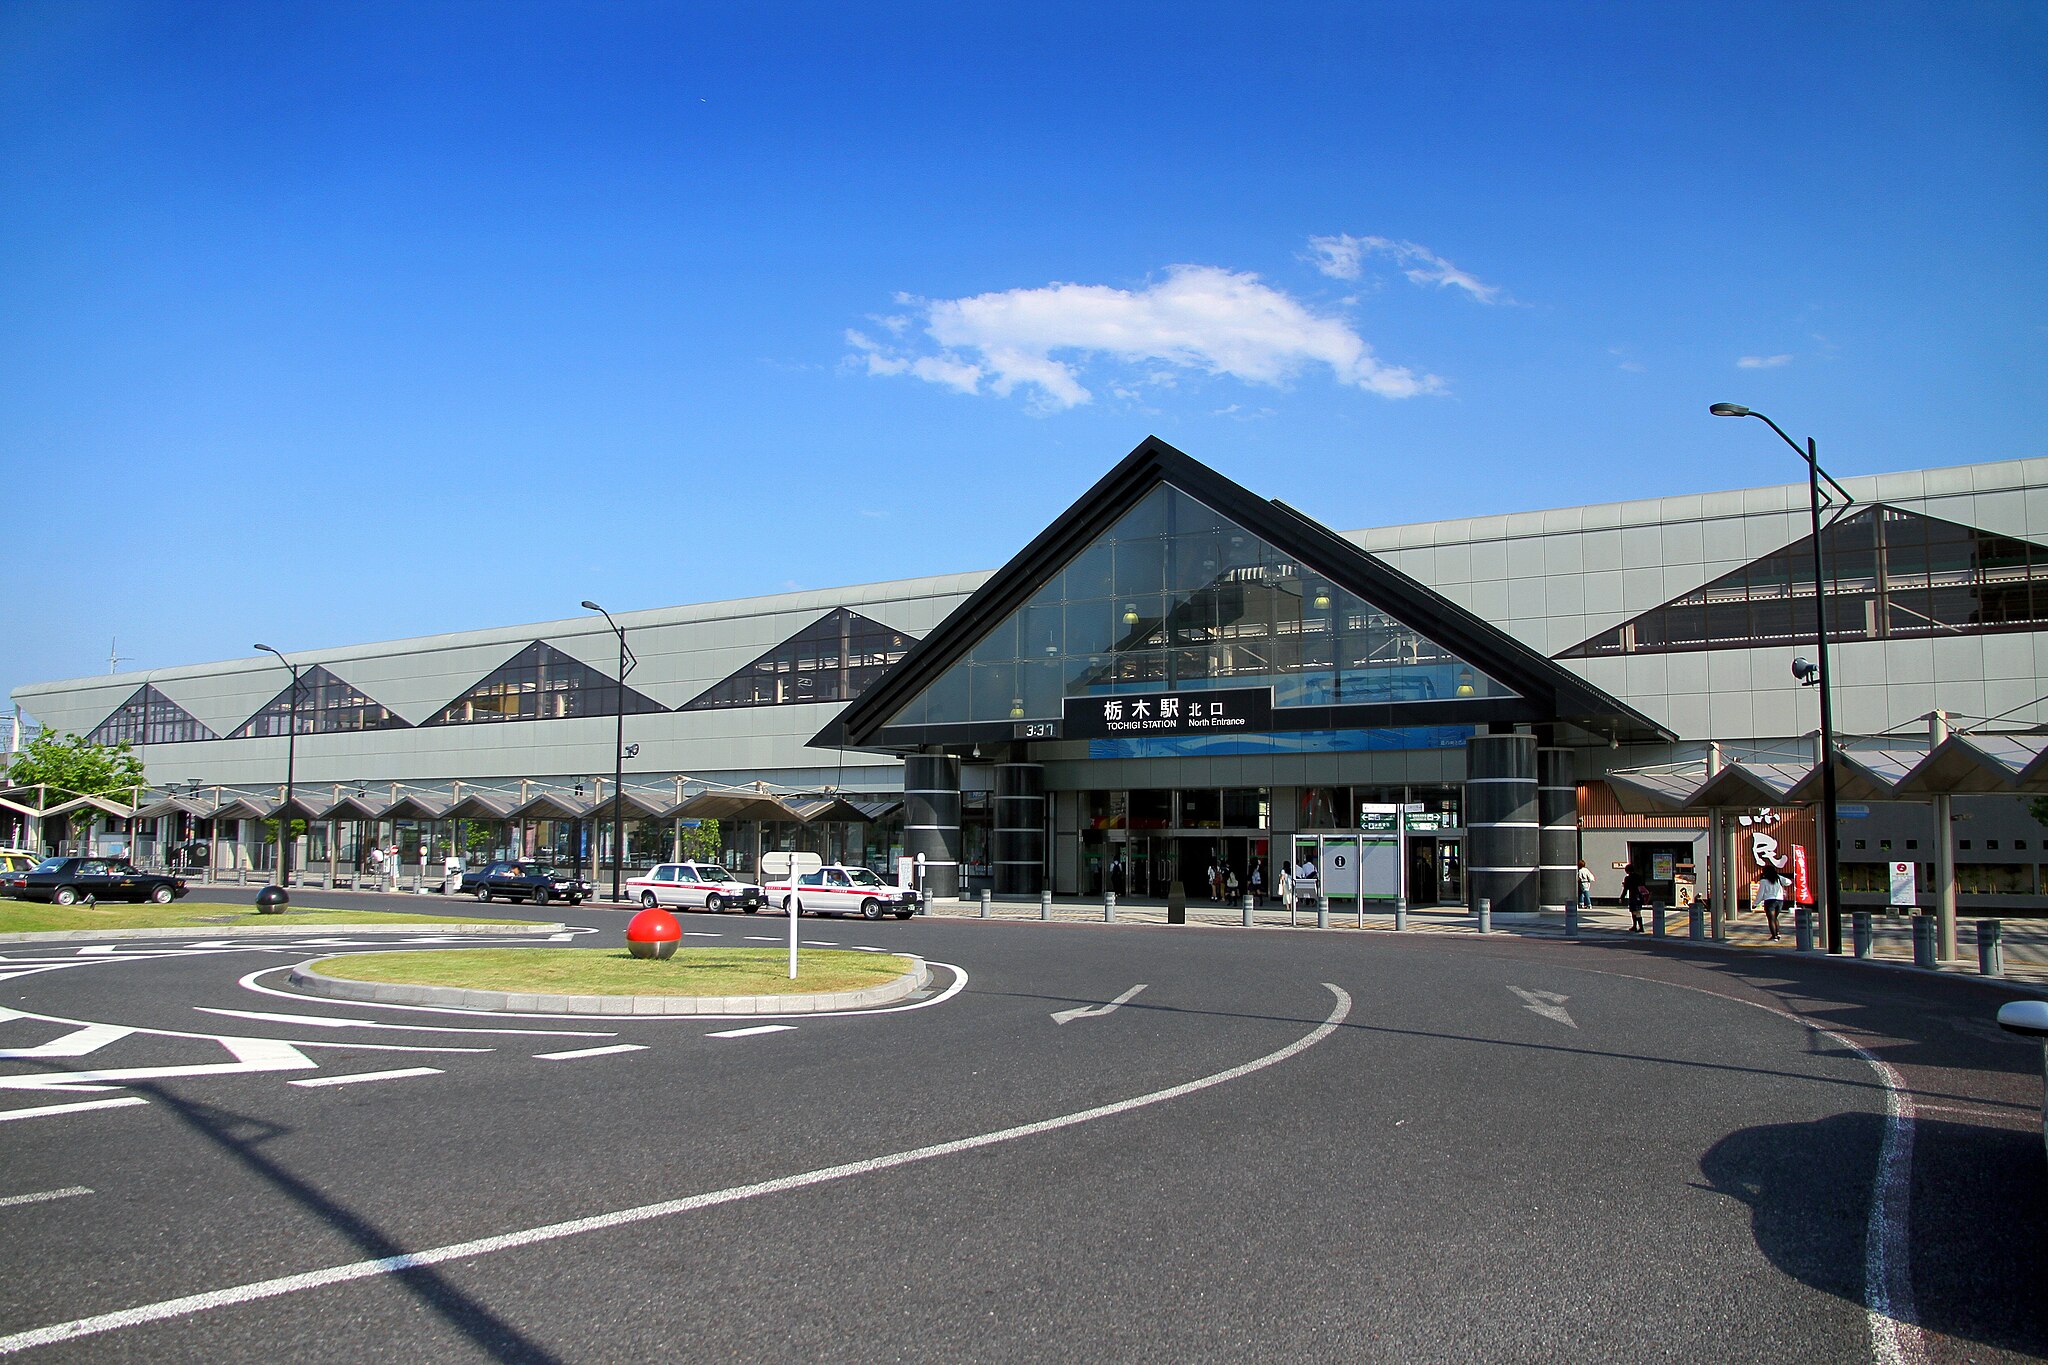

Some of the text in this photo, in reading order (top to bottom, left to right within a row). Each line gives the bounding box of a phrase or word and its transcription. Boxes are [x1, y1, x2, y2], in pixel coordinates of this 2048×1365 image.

[1103, 697, 1224, 721] 栃木駅 北口
[1026, 723, 1053, 736] 3:37
[1106, 718, 1246, 730] TOCHIGI STATION North Entrance
